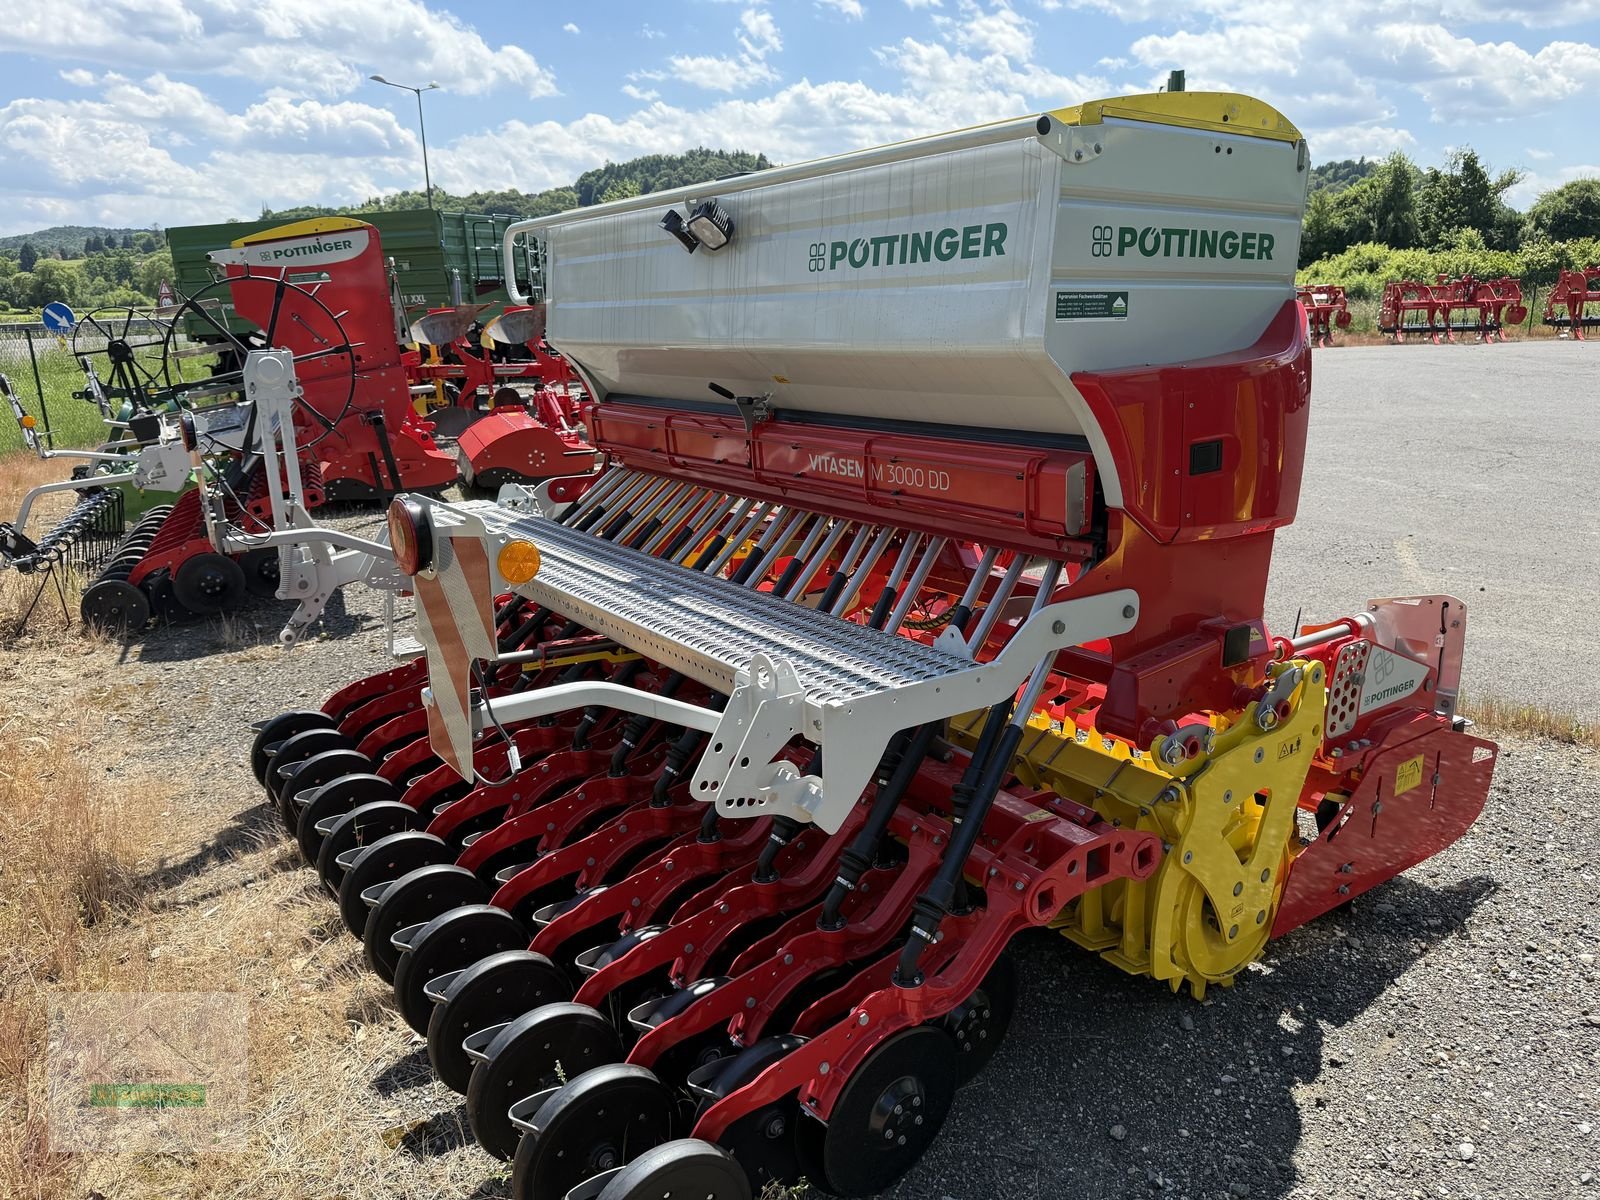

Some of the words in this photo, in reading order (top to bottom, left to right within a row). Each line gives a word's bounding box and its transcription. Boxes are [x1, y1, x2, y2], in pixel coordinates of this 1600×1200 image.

[410, 294, 427, 303] XXL
[808, 453, 865, 479] VITASEM
[871, 463, 884, 482] M
[886, 464, 924, 488] 3000
[928, 470, 950, 491] DD
